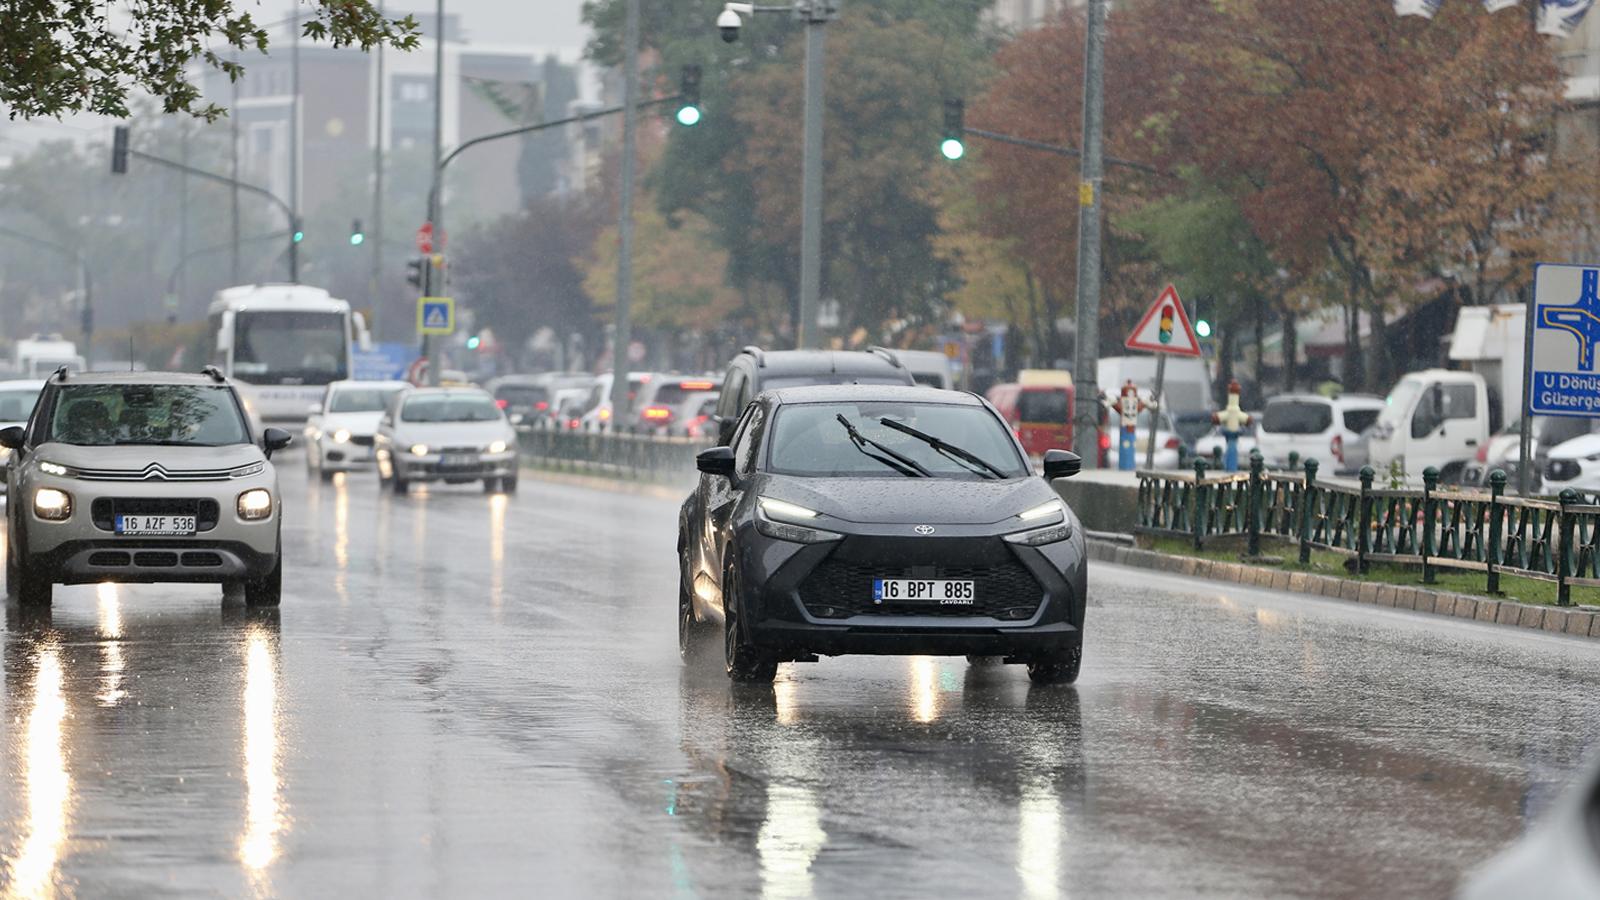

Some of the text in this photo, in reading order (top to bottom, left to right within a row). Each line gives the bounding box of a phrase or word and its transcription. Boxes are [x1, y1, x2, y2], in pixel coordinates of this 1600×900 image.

[1544, 374, 1555, 388] U
[125, 517, 194, 530] 16 AZF 536
[883, 581, 972, 598] 16 BPT 885
